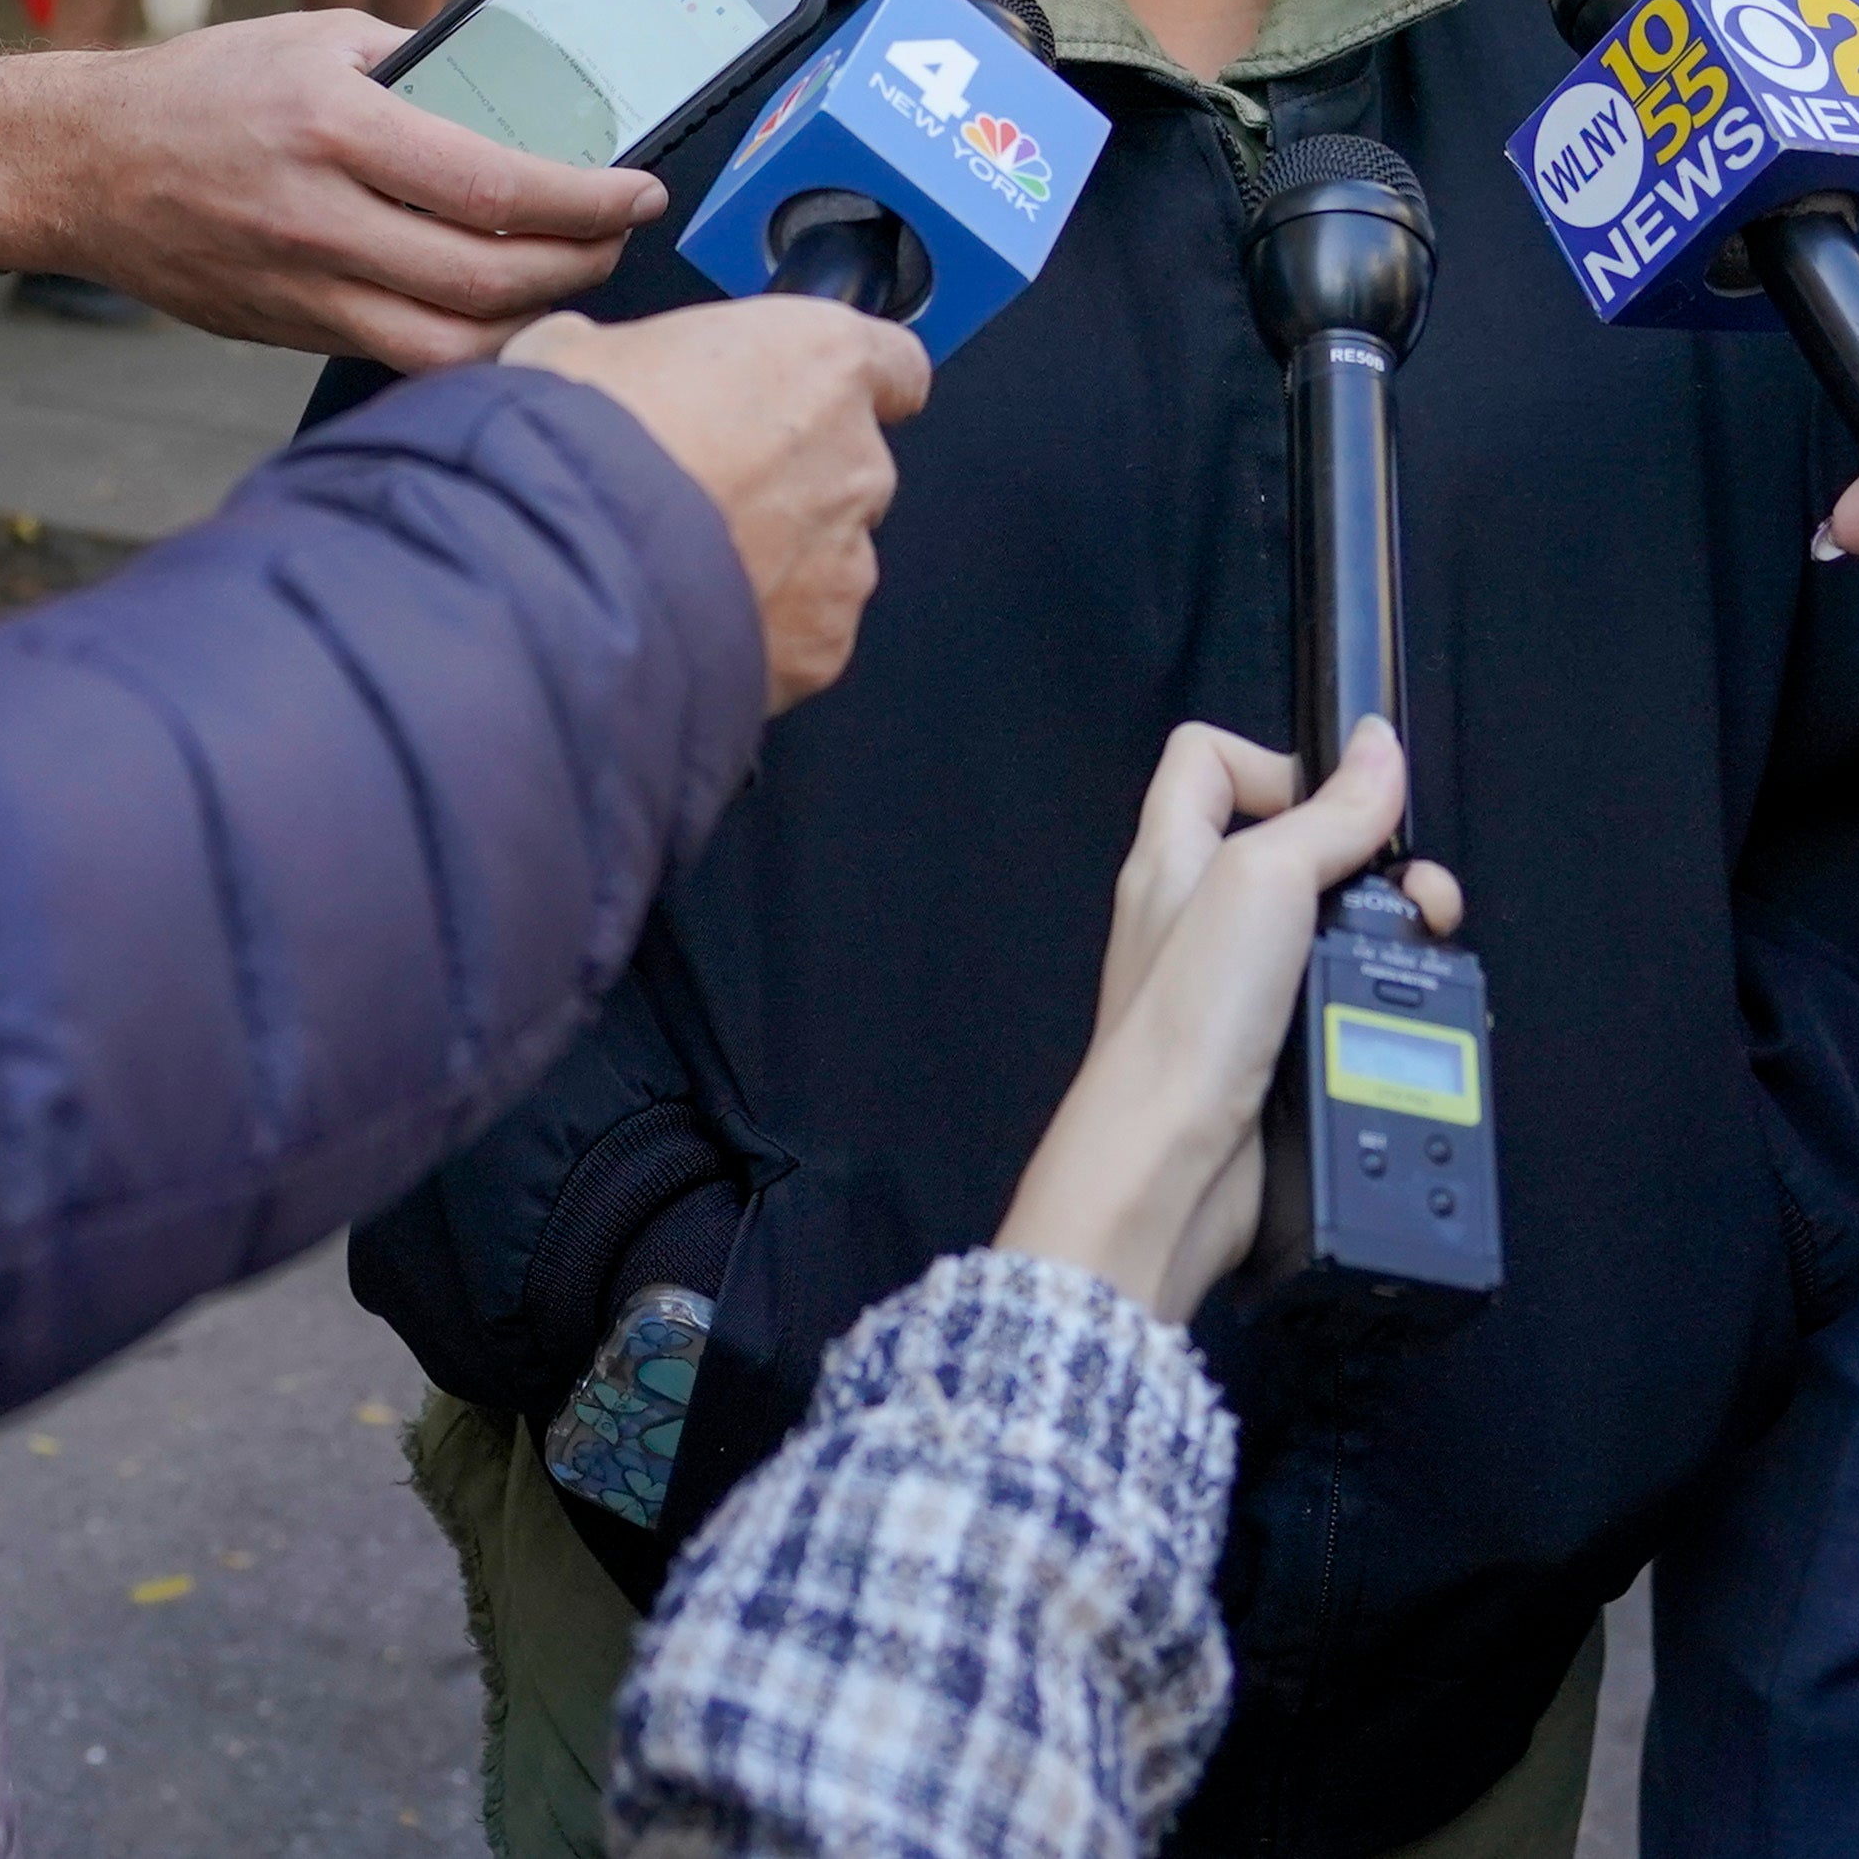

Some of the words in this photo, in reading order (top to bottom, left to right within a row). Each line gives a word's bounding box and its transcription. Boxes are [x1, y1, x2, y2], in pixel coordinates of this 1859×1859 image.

[868, 71, 946, 139] NEW
[884, 39, 980, 123] 4
[952, 134, 1041, 224] YORK
[1540, 97, 1629, 205] WLNY
[1582, 106, 1766, 304] NEWS
[1342, 891, 1420, 922] SONY
